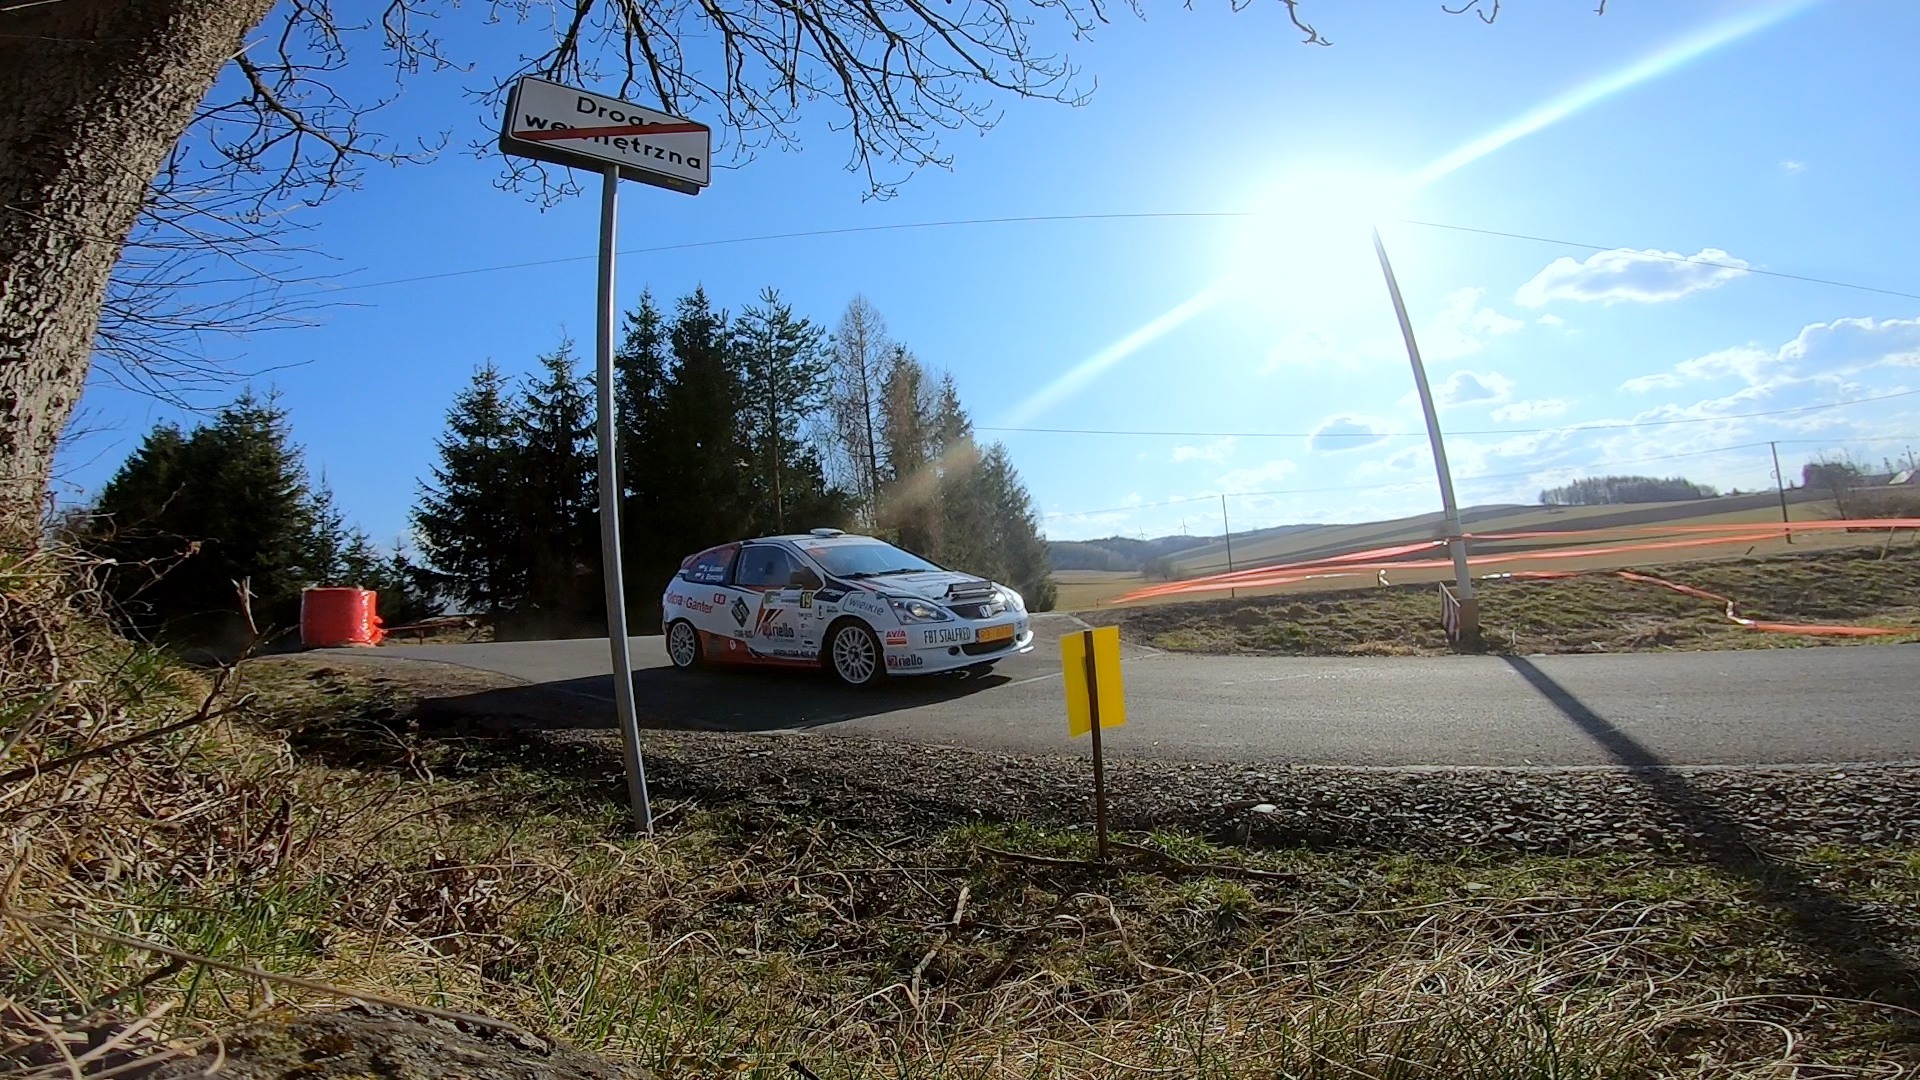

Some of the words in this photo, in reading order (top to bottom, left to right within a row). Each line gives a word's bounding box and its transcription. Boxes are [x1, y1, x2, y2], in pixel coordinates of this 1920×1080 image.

[577, 96, 662, 126] Drog
[802, 592, 812, 608] 19
[886, 630, 906, 638] AVIA
[924, 630, 937, 644] FBT
